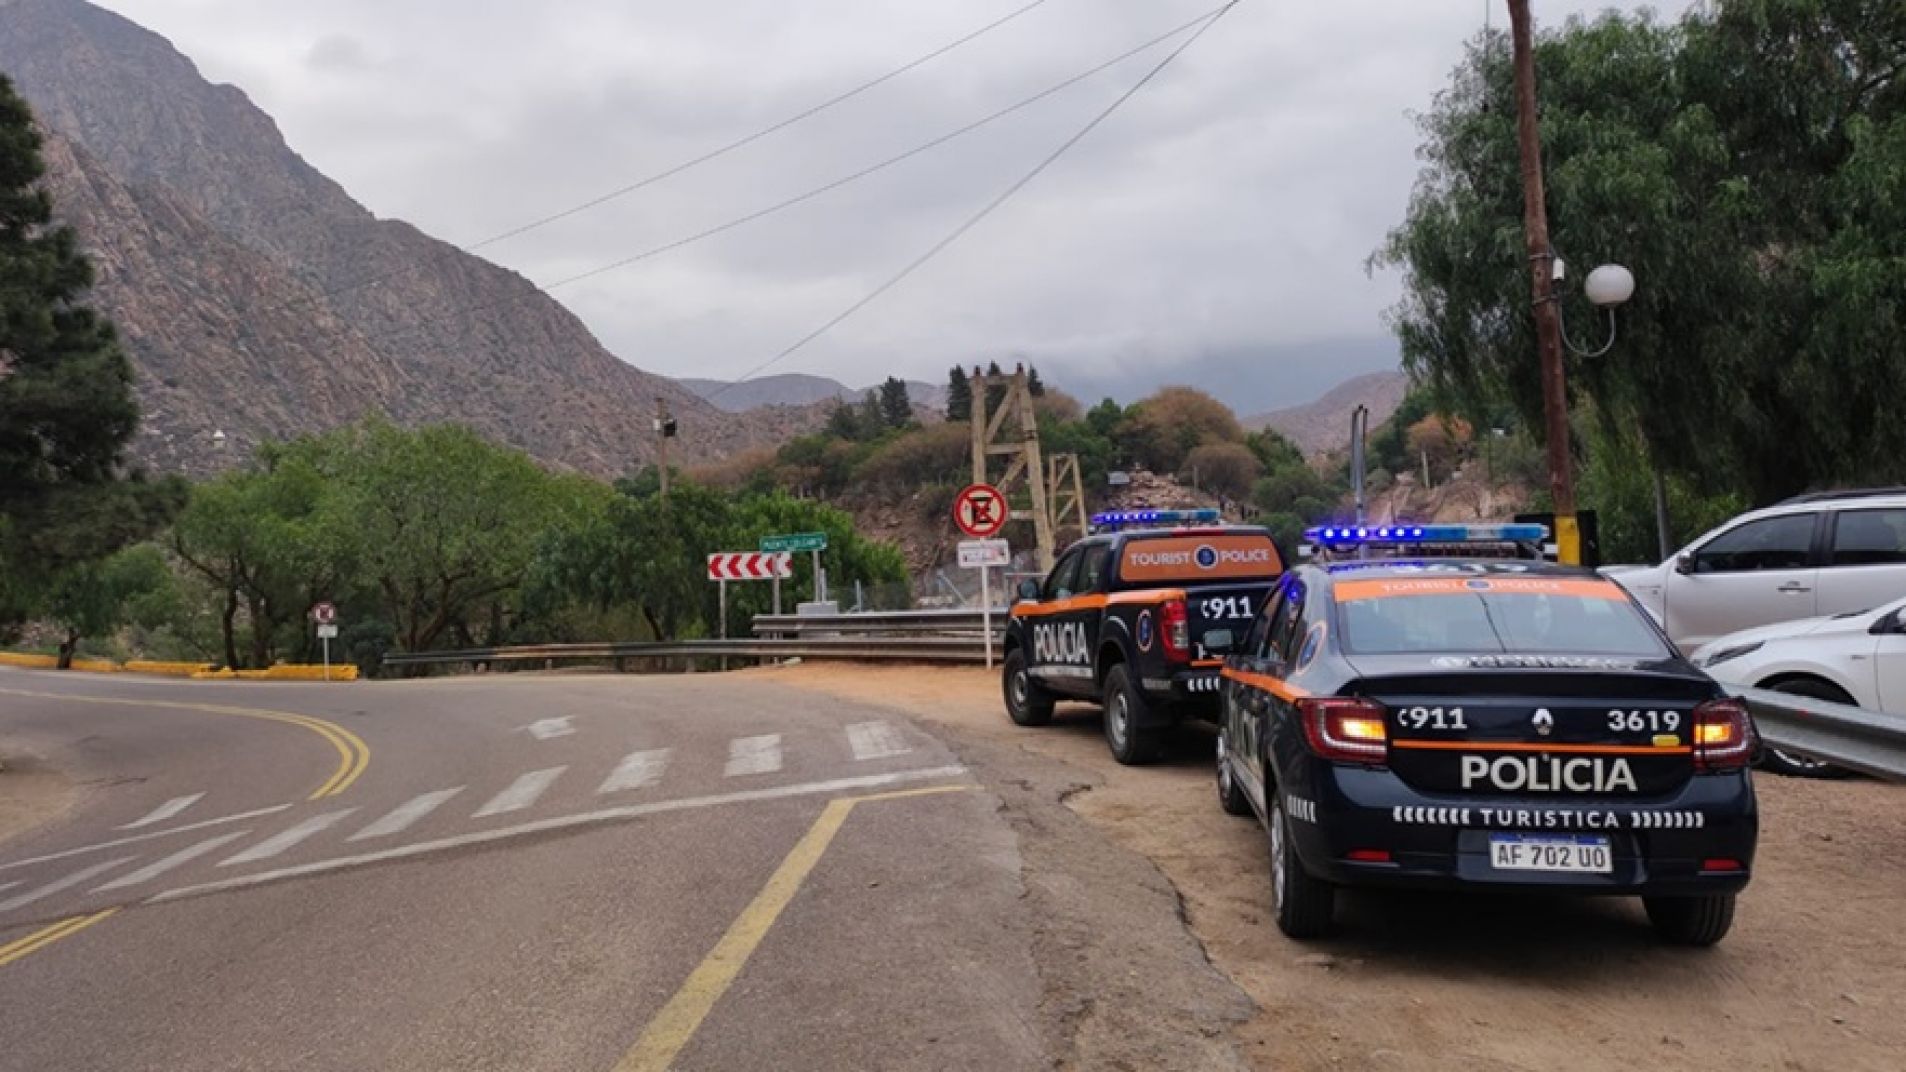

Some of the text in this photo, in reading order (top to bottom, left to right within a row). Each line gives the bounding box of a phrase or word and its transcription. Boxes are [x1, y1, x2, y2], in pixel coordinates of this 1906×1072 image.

[1130, 549, 1269, 566] TOURIST POLICE
[1210, 596, 1254, 620] 911
[1033, 621, 1091, 664] POLICIA
[1409, 706, 1468, 730] 911
[1607, 709, 1681, 732] 3619
[1460, 754, 1638, 793] POLICIA
[1479, 809, 1620, 829] TURISTICA
[1497, 843, 1522, 866] AF
[1530, 845, 1571, 868] 702
